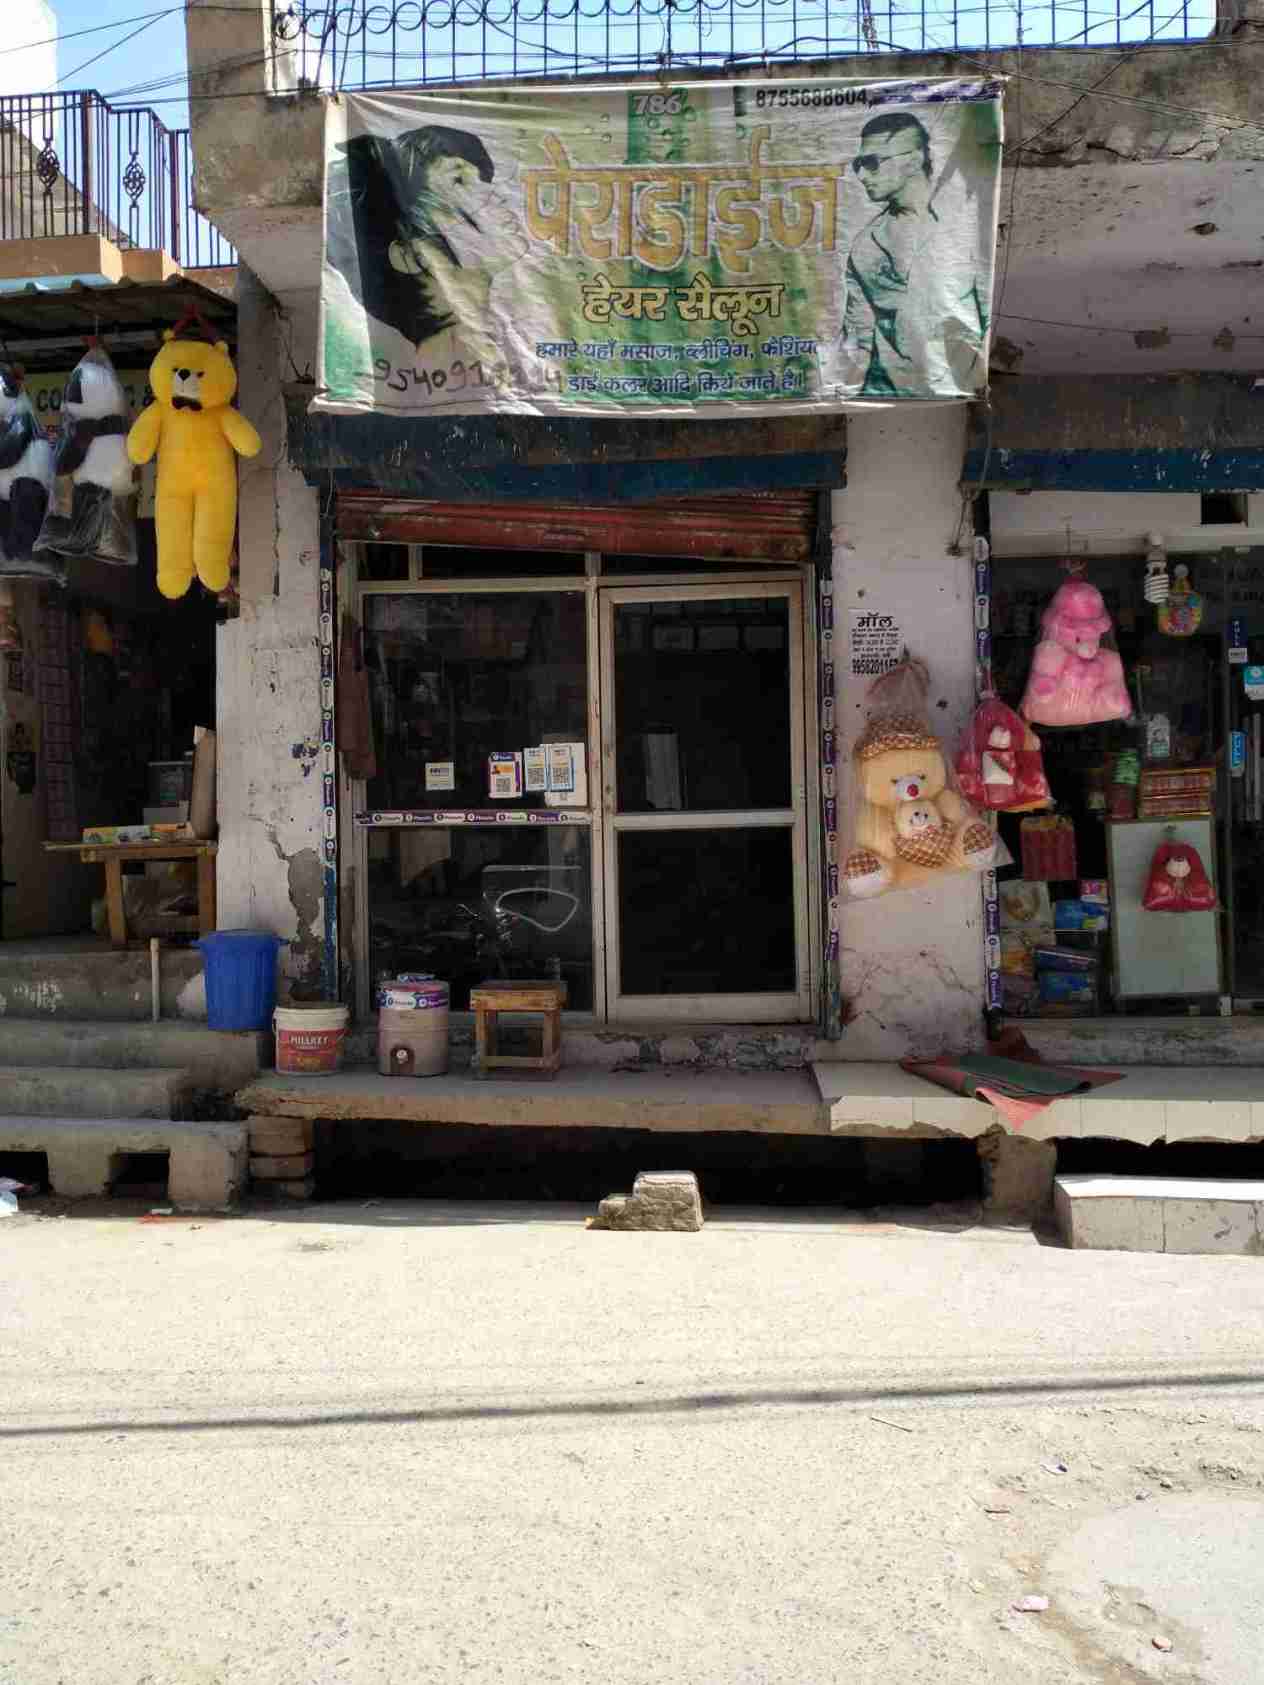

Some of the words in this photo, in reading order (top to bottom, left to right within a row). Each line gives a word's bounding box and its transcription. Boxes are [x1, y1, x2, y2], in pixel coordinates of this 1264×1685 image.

[633, 94, 682, 116] 786
[581, 272, 669, 323] हेयर
[535, 338, 577, 359] हमारे
[653, 370, 690, 394] आदि
[738, 370, 777, 391] जाते
[856, 612, 894, 628] मॉल
